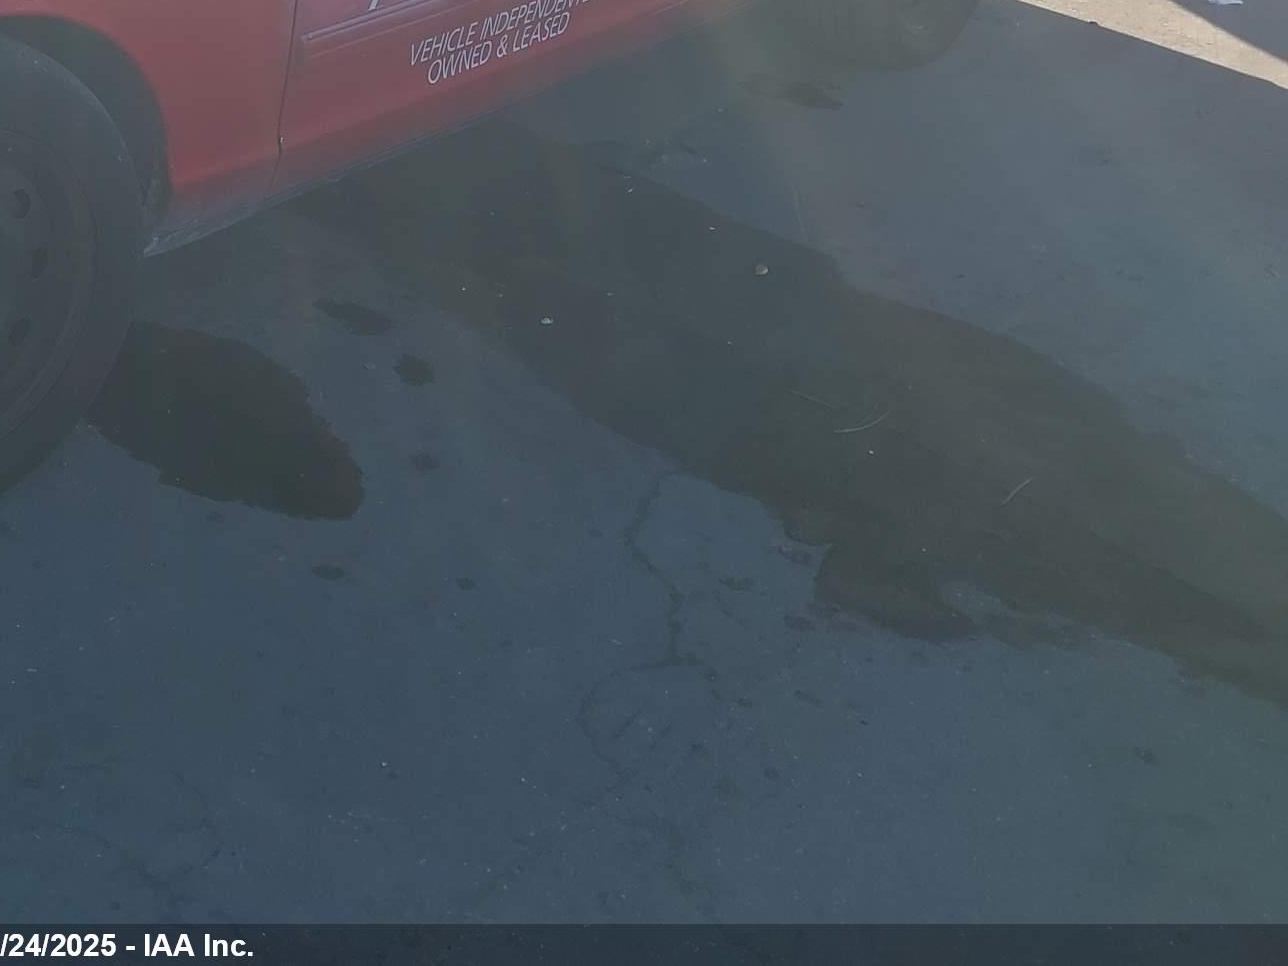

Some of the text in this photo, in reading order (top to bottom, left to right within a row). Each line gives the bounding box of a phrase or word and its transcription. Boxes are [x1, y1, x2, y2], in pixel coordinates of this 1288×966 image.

[410, 21, 477, 67] VEHICLE
[427, 10, 572, 85] OWNED & LEASED
